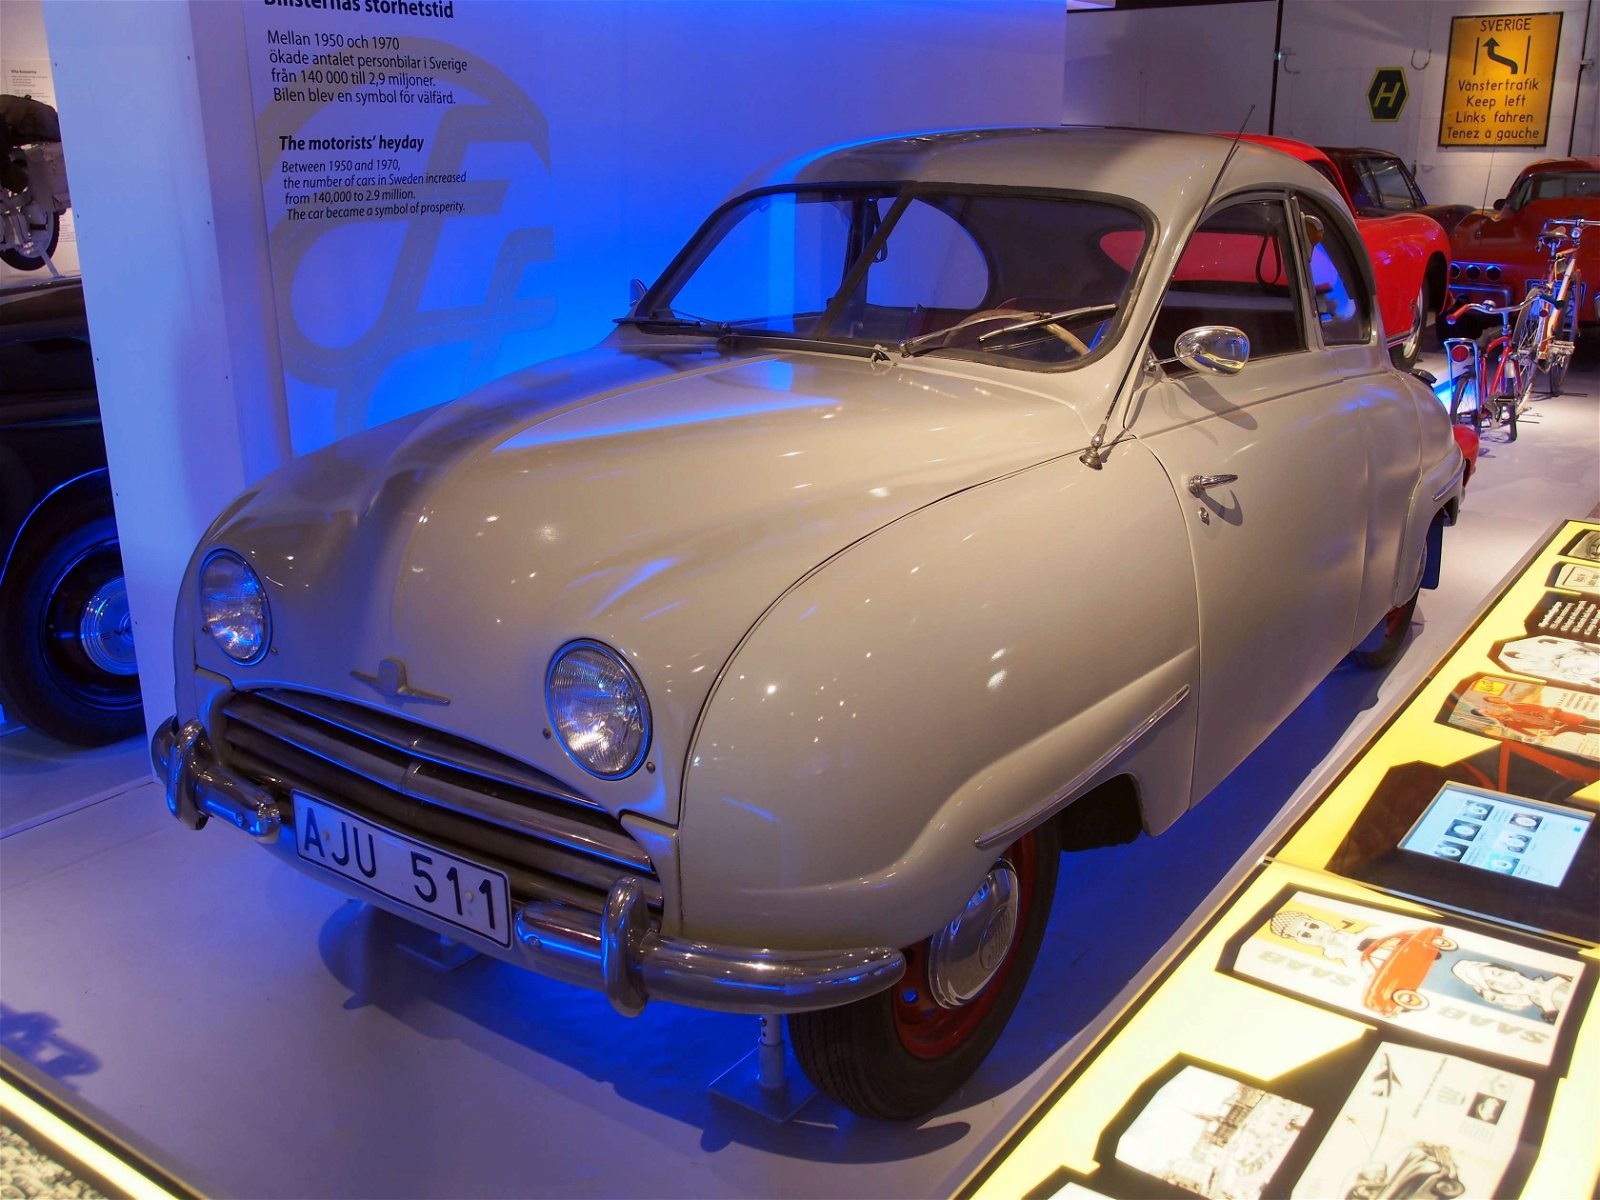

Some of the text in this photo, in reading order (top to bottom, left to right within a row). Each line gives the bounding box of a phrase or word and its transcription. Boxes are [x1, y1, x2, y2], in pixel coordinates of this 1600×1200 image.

[365, 0, 453, 18] storhetstid
[1480, 18, 1531, 32] SVERIGE
[268, 30, 399, 50] Mellan 1950 och 1970
[269, 49, 467, 73] ökade antalet personbilar i Sverige
[271, 67, 436, 89] från 140 000 till 2,9 miljoner.
[274, 87, 456, 106] Bilen blev en symbol för välfärd.
[1373, 82, 1401, 108] H
[1466, 94, 1526, 110] Keep left
[1456, 111, 1533, 123] Links fahren
[1447, 126, 1480, 139] Tenez
[1496, 126, 1539, 141] gauche
[279, 135, 305, 151] The
[379, 134, 424, 153] heyday
[282, 159, 401, 173] Between 1950 and 1970,
[283, 171, 466, 189] the number of cars in Sweden increased
[285, 188, 416, 205] from 140,000 to 2.9 million.
[286, 201, 465, 220] The car became a symbol of prosperity.
[304, 807, 496, 930] AJU 511
[1258, 951, 1357, 987] SAAB
[1437, 1006, 1550, 1044] SAAB
